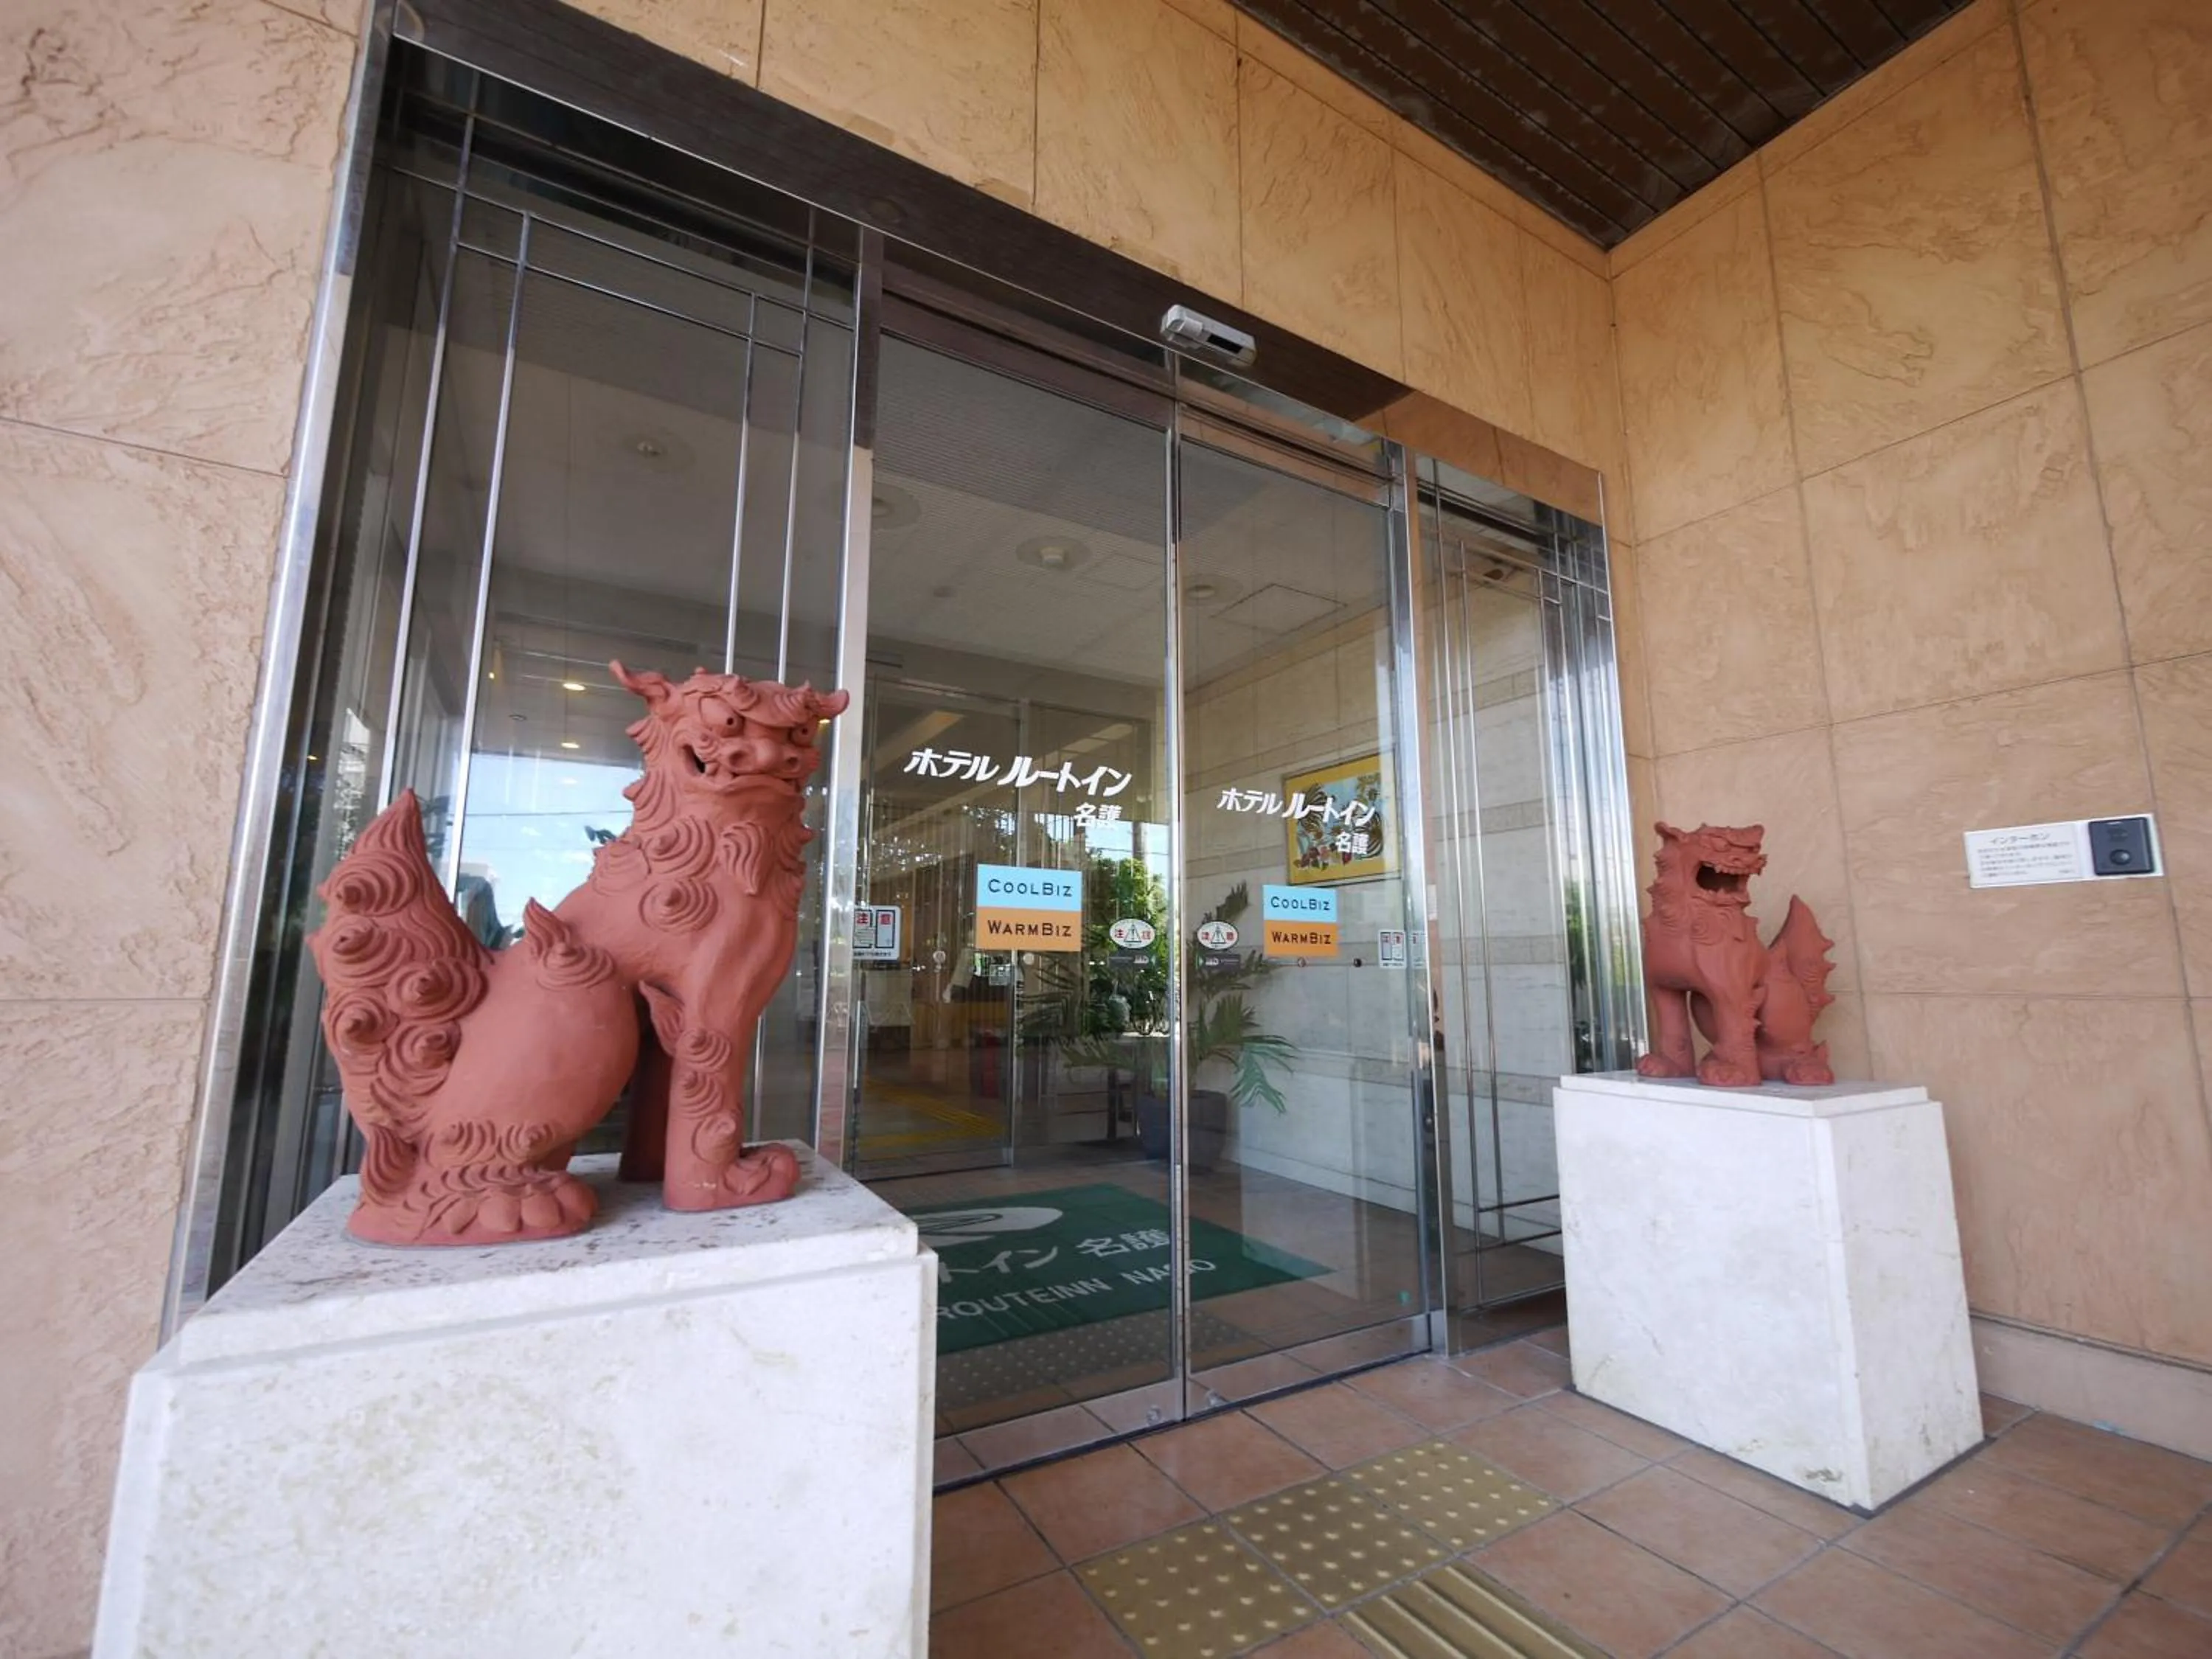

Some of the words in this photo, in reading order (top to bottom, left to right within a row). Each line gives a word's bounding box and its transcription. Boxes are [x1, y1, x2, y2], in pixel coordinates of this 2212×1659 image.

[903, 748, 1001, 782] ホテル
[997, 755, 1132, 796] ルートイン
[1074, 802, 1122, 827] 名護
[1217, 787, 1283, 815] ホテル
[1281, 793, 1375, 826] ルートイン
[1335, 831, 1369, 855] 名護
[1076, 1228, 1170, 1257] 名護
